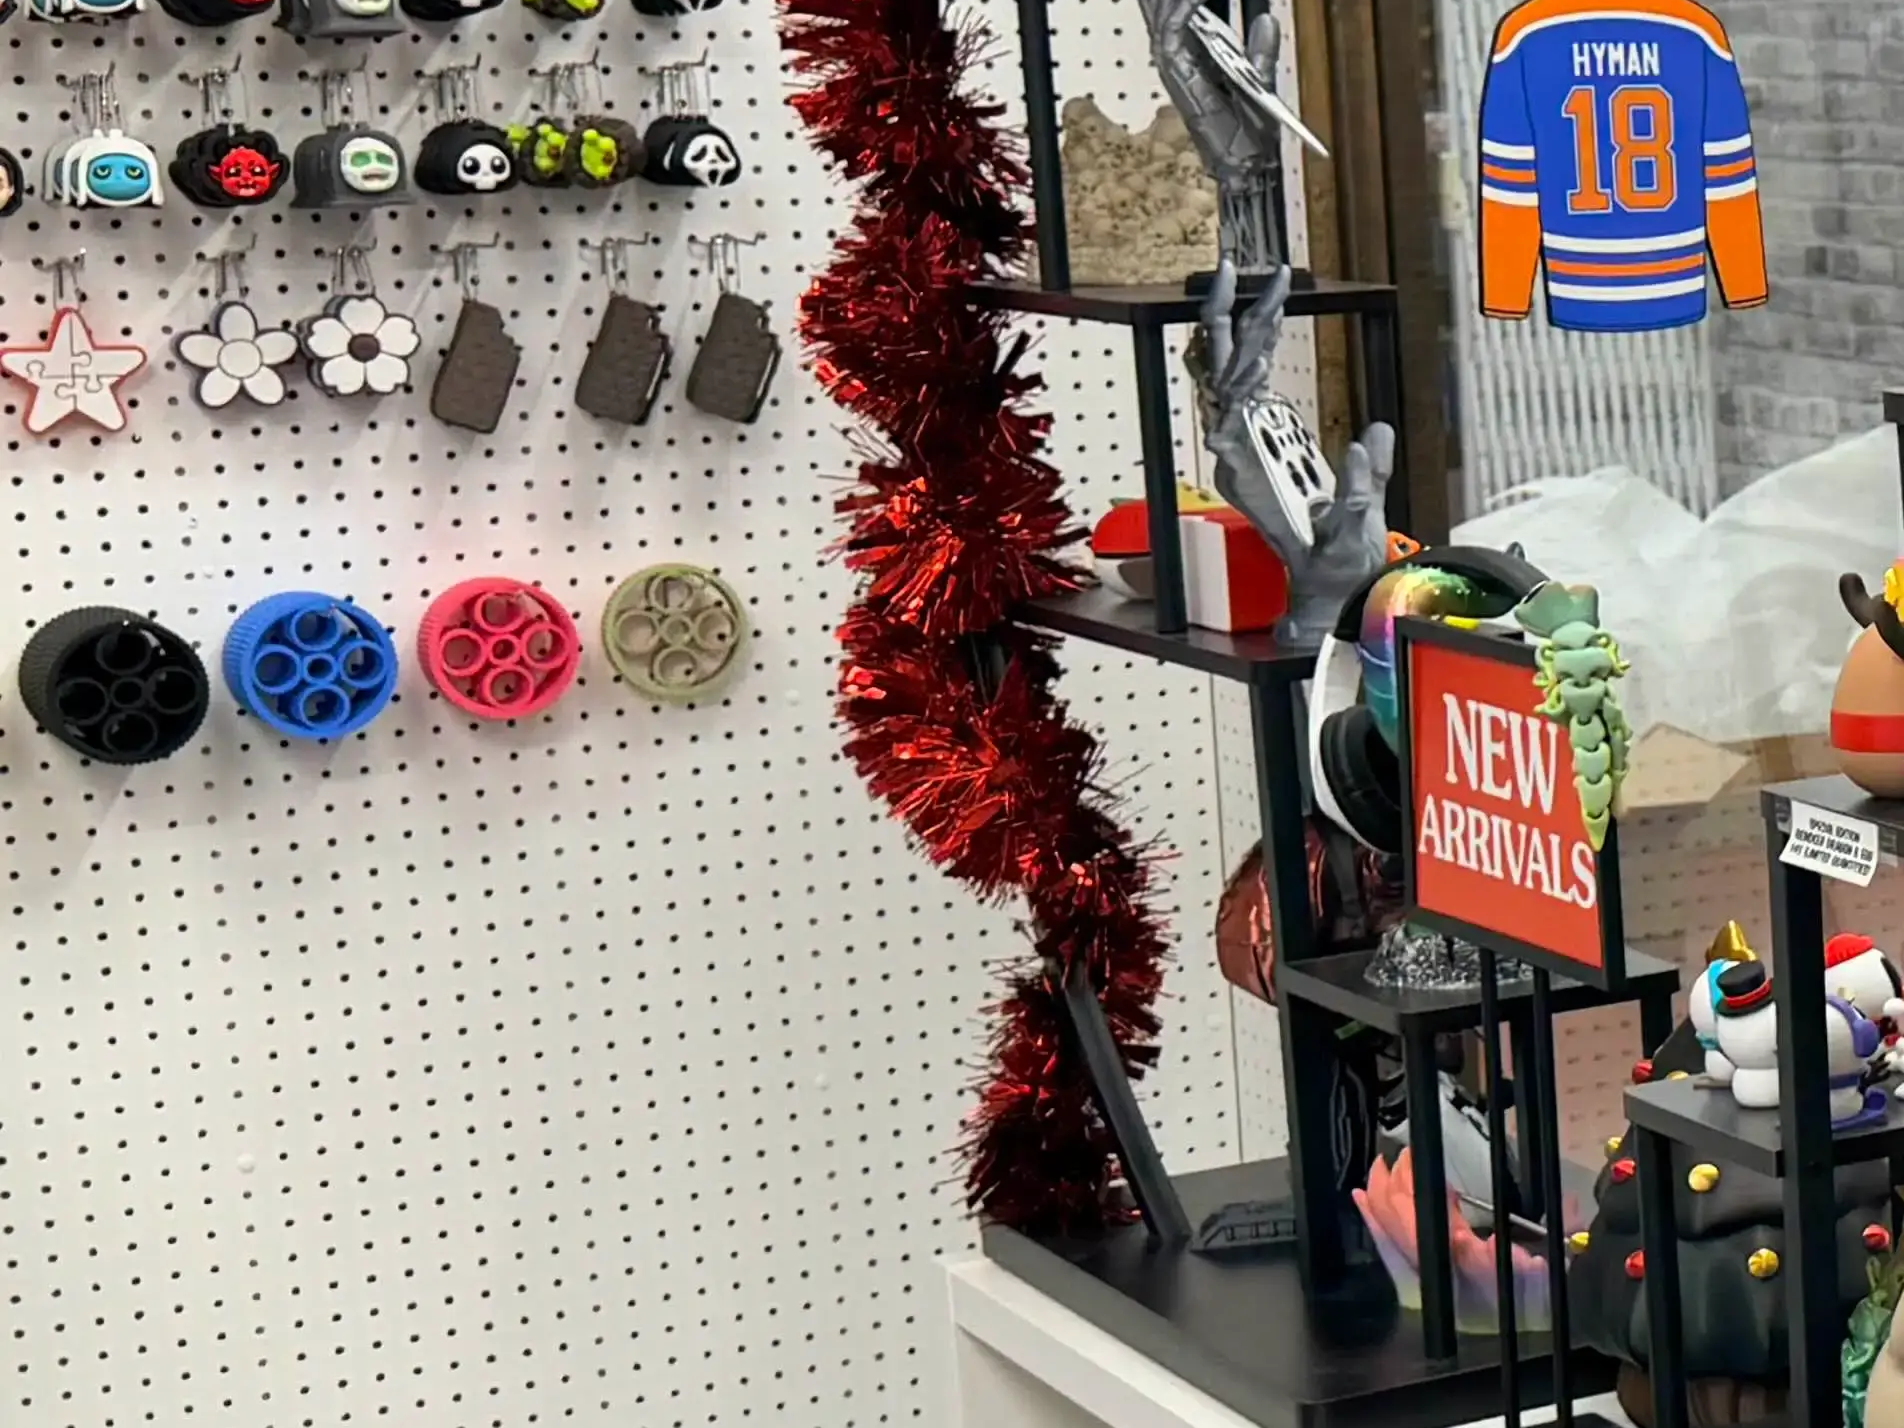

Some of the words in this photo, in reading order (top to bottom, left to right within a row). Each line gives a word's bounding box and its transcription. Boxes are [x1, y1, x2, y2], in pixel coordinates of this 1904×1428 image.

[1572, 42, 1661, 77] HYMAN
[1561, 83, 1678, 216] 18
[1442, 692, 1559, 816] NEW
[1418, 793, 1598, 910] ARRIVALS
